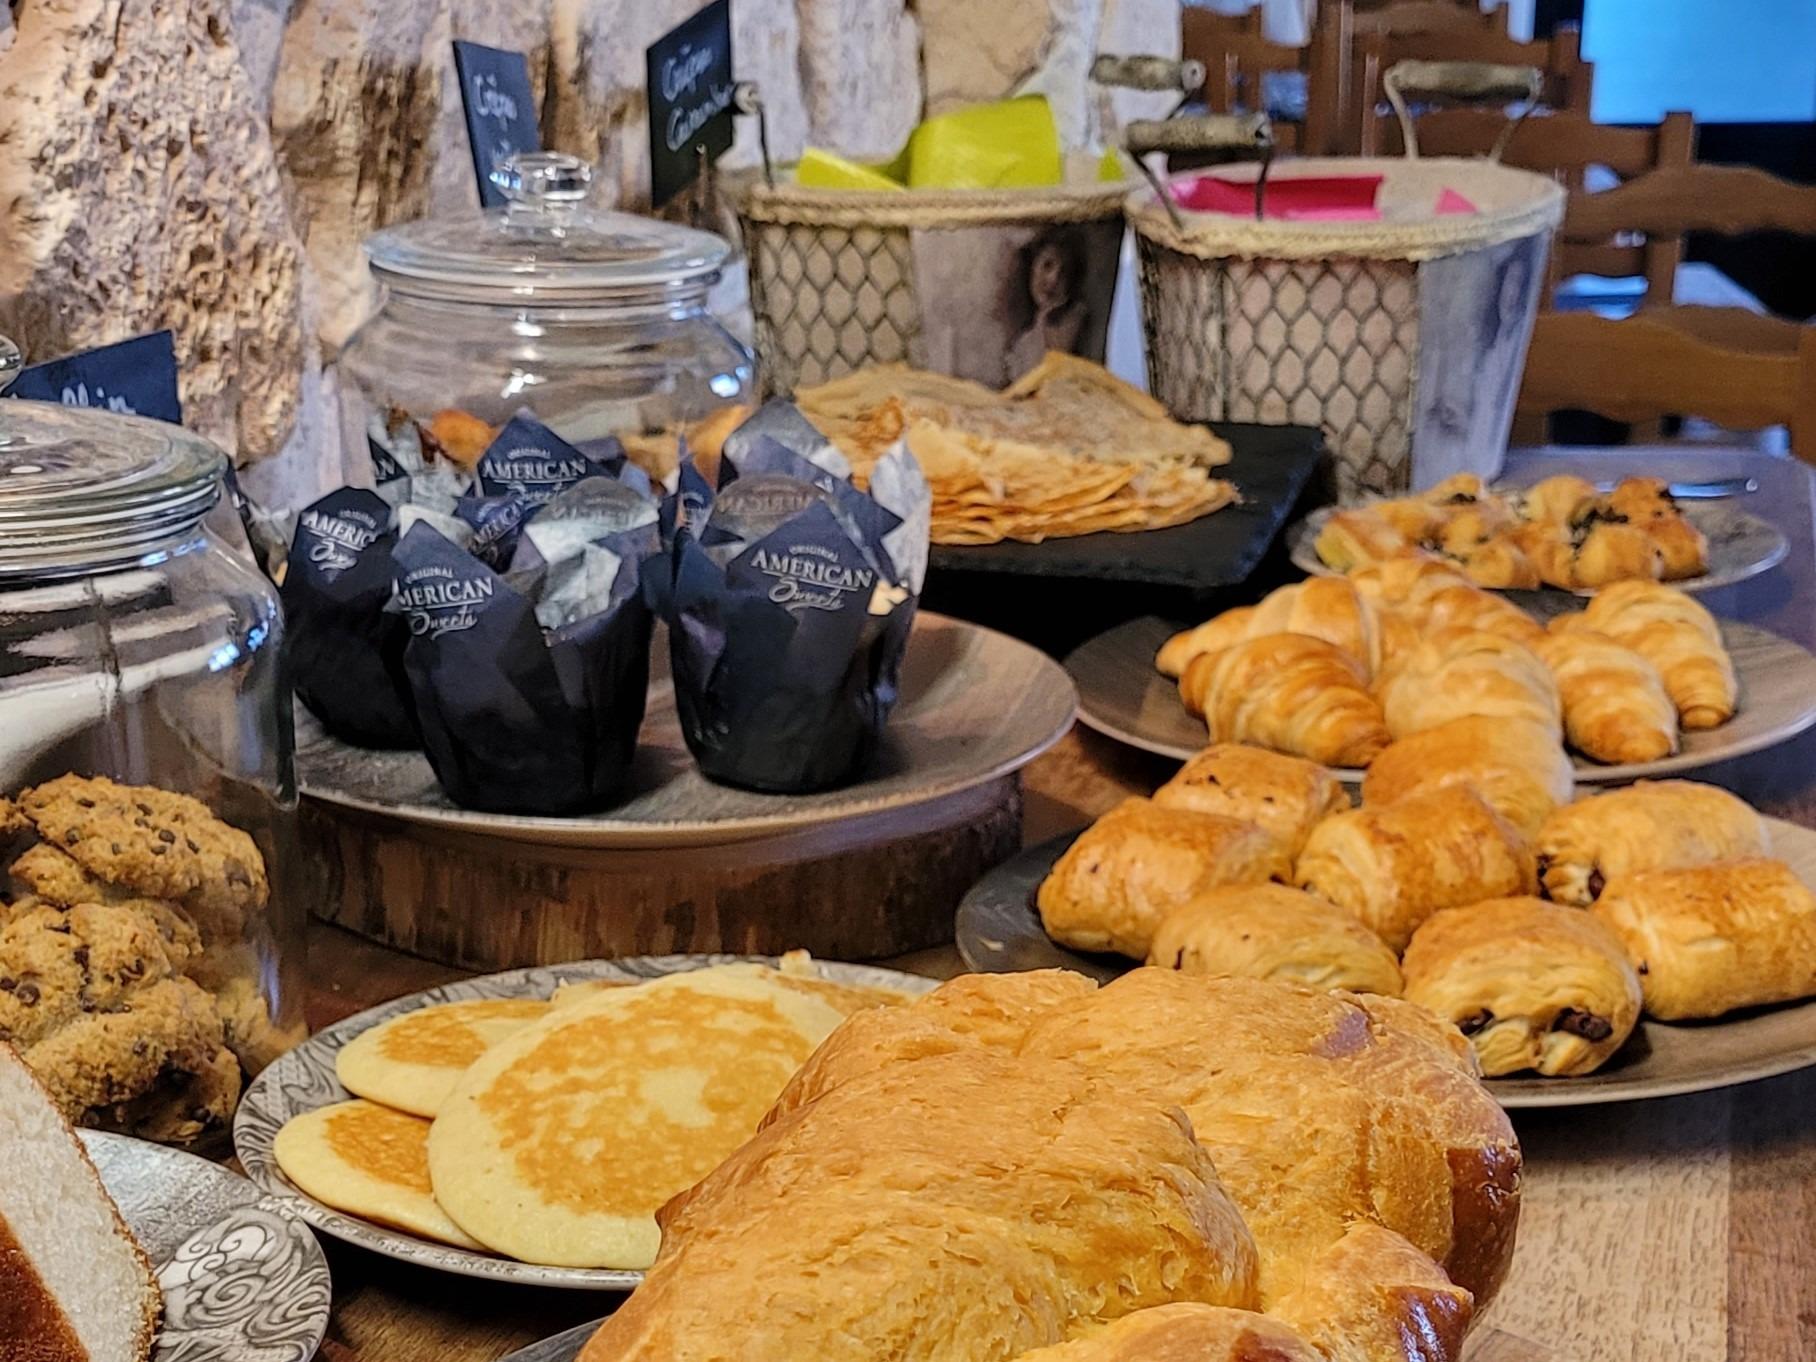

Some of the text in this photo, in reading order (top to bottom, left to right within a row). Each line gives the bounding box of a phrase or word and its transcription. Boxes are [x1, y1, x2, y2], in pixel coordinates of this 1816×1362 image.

[482, 458, 586, 481] AMERICAN
[301, 509, 381, 549] AMERIC
[751, 549, 873, 588] AMERICAN
[397, 576, 493, 607] MERICAN
[768, 576, 845, 611] Sweets
[410, 603, 478, 640] Sweets
